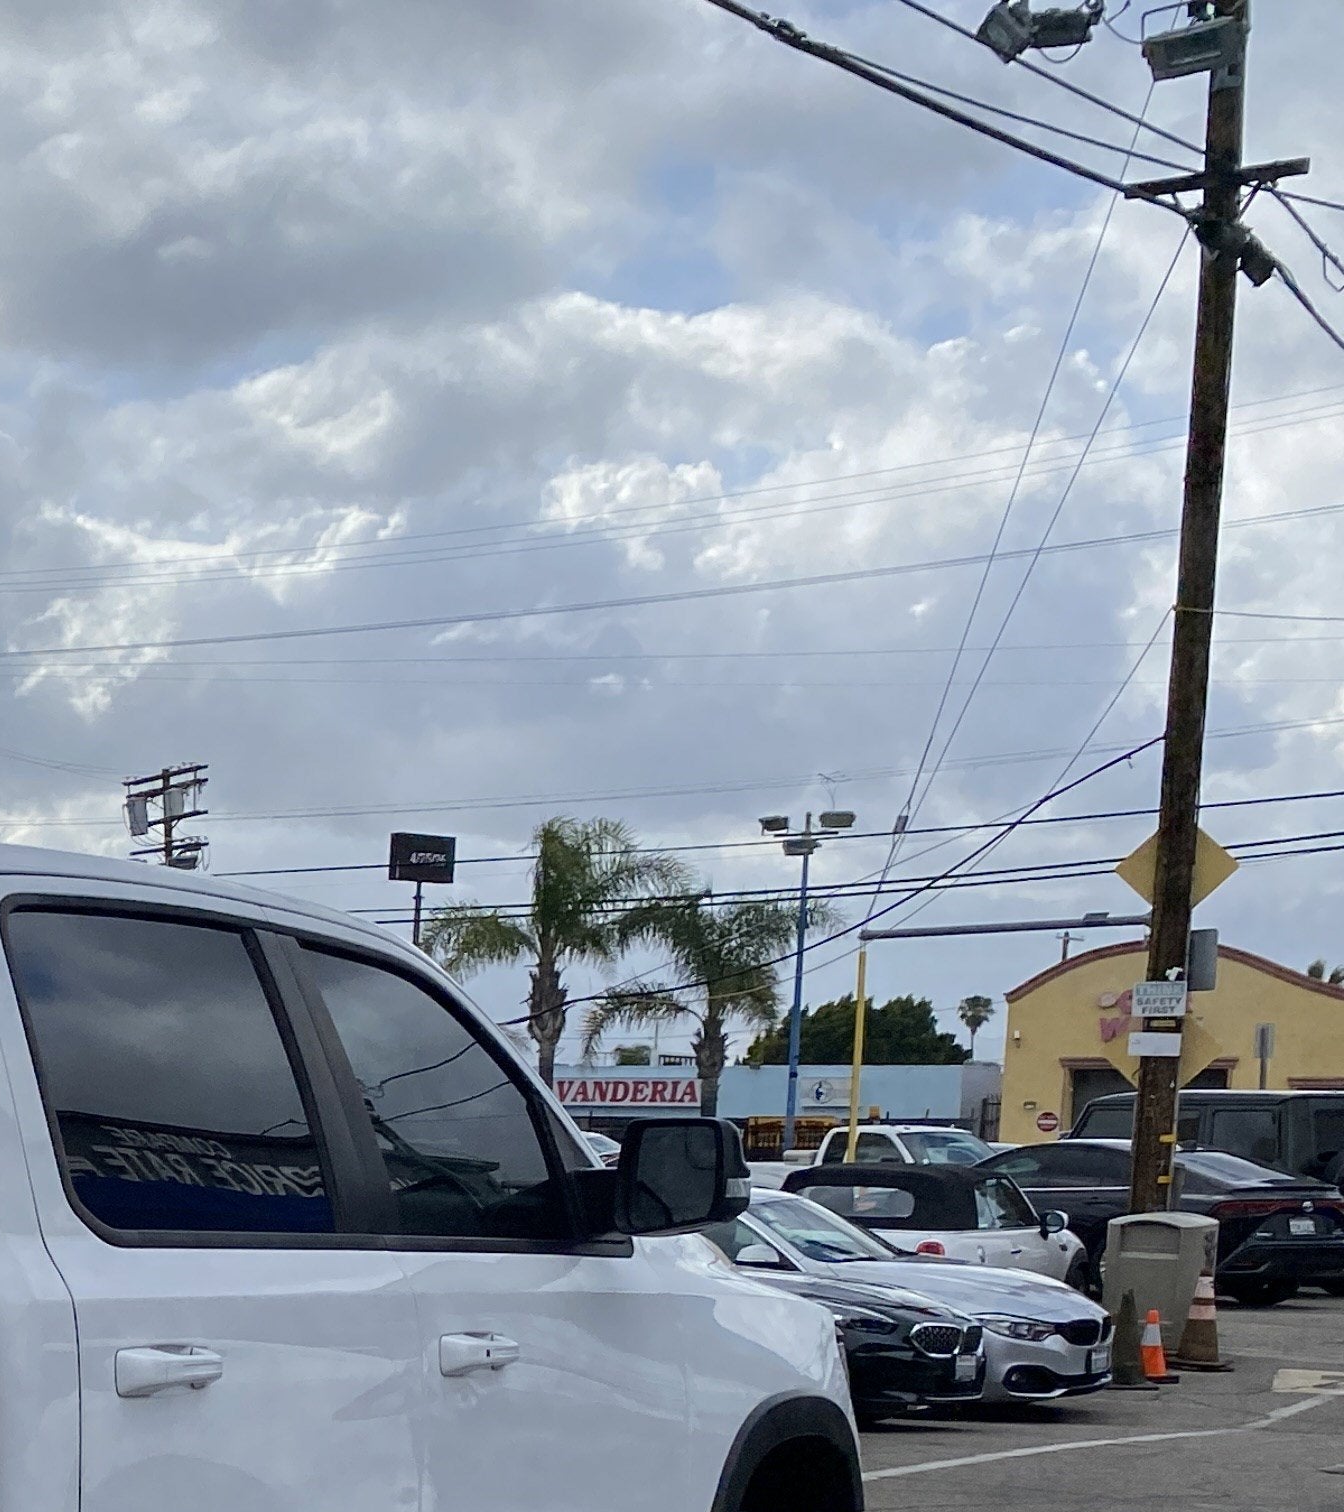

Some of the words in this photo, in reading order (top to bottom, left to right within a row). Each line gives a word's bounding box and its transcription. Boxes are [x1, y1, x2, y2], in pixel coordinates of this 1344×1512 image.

[1137, 997, 1182, 1006] SAFETY
[1142, 1006, 1175, 1014] FIRST
[556, 1080, 698, 1103] VANDERIA
